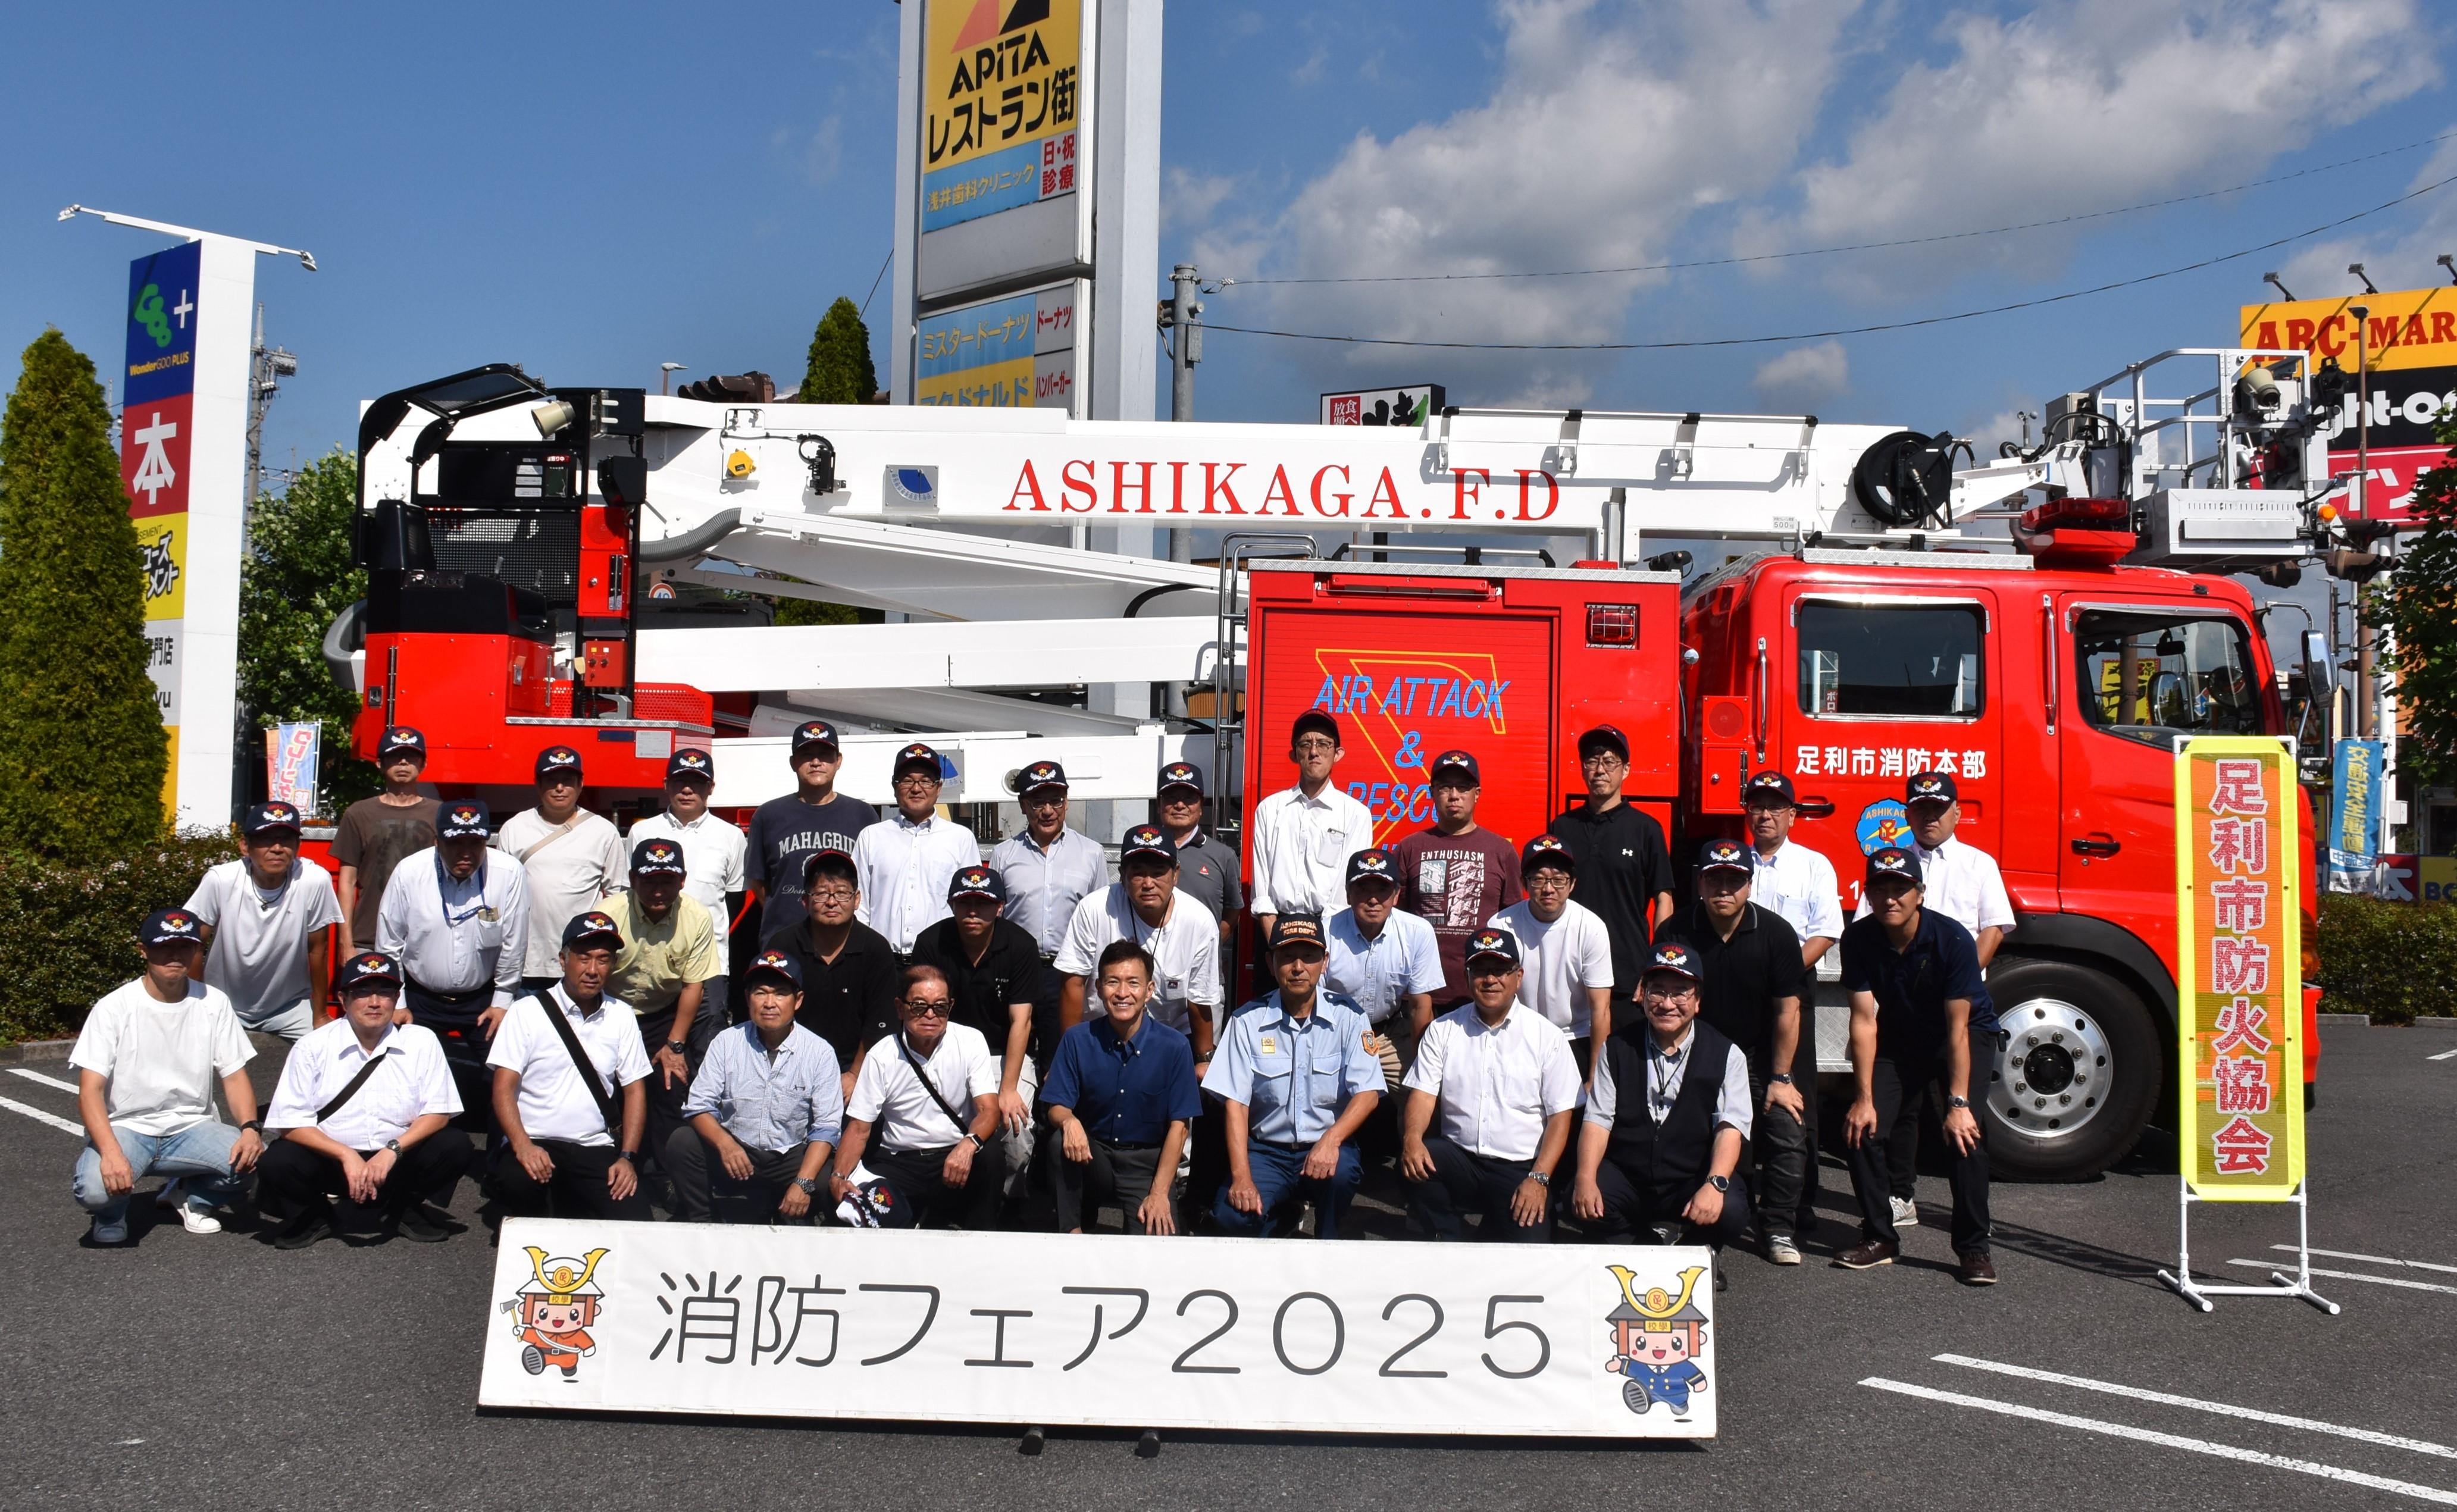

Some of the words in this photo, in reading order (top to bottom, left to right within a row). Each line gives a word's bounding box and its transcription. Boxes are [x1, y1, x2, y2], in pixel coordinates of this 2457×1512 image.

[928, 65, 1076, 164] レストラン街
[927, 163, 1035, 213] 浅井歯科クリニック
[1043, 165, 1074, 195] 診療
[922, 312, 1031, 361] ミスタードーナツ
[1037, 305, 1072, 334] ドーナツ
[172, 352, 189, 365] PLUS
[1035, 370, 1071, 399] ハンバーガー
[133, 412, 177, 505] 本
[1002, 459, 1560, 521] ASHIKAGA.F.D
[138, 524, 163, 541] SEMENT
[1312, 675, 1373, 713] AIR
[1379, 676, 1512, 719] ATTACK
[1394, 730, 1425, 768] &
[1795, 745, 1986, 780] 足利市消防本部
[1866, 807, 1906, 819] ASHIKAG
[1421, 850, 1484, 862] ENTHUSIASM
[1279, 921, 1317, 931] ASHIKAGA
[1298, 927, 1316, 937] DEPT.
[2209, 760, 2273, 1175] 足利市防火協会
[650, 1270, 1553, 1382] 消防フェア2025
